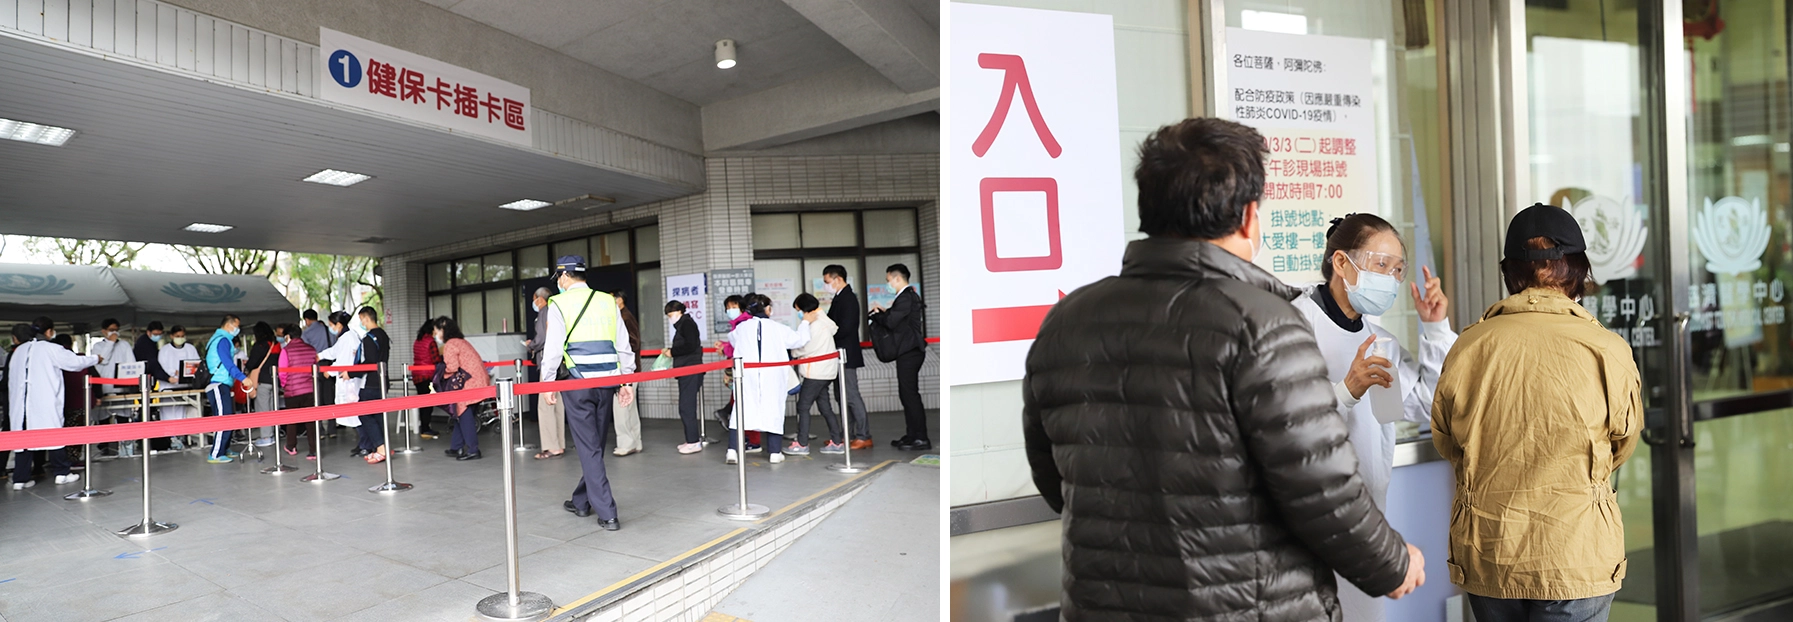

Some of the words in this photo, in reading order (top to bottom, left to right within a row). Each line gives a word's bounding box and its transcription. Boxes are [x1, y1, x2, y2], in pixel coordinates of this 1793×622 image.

[366, 58, 526, 131] 健保卡插卡區
[971, 53, 1063, 272] 入口
